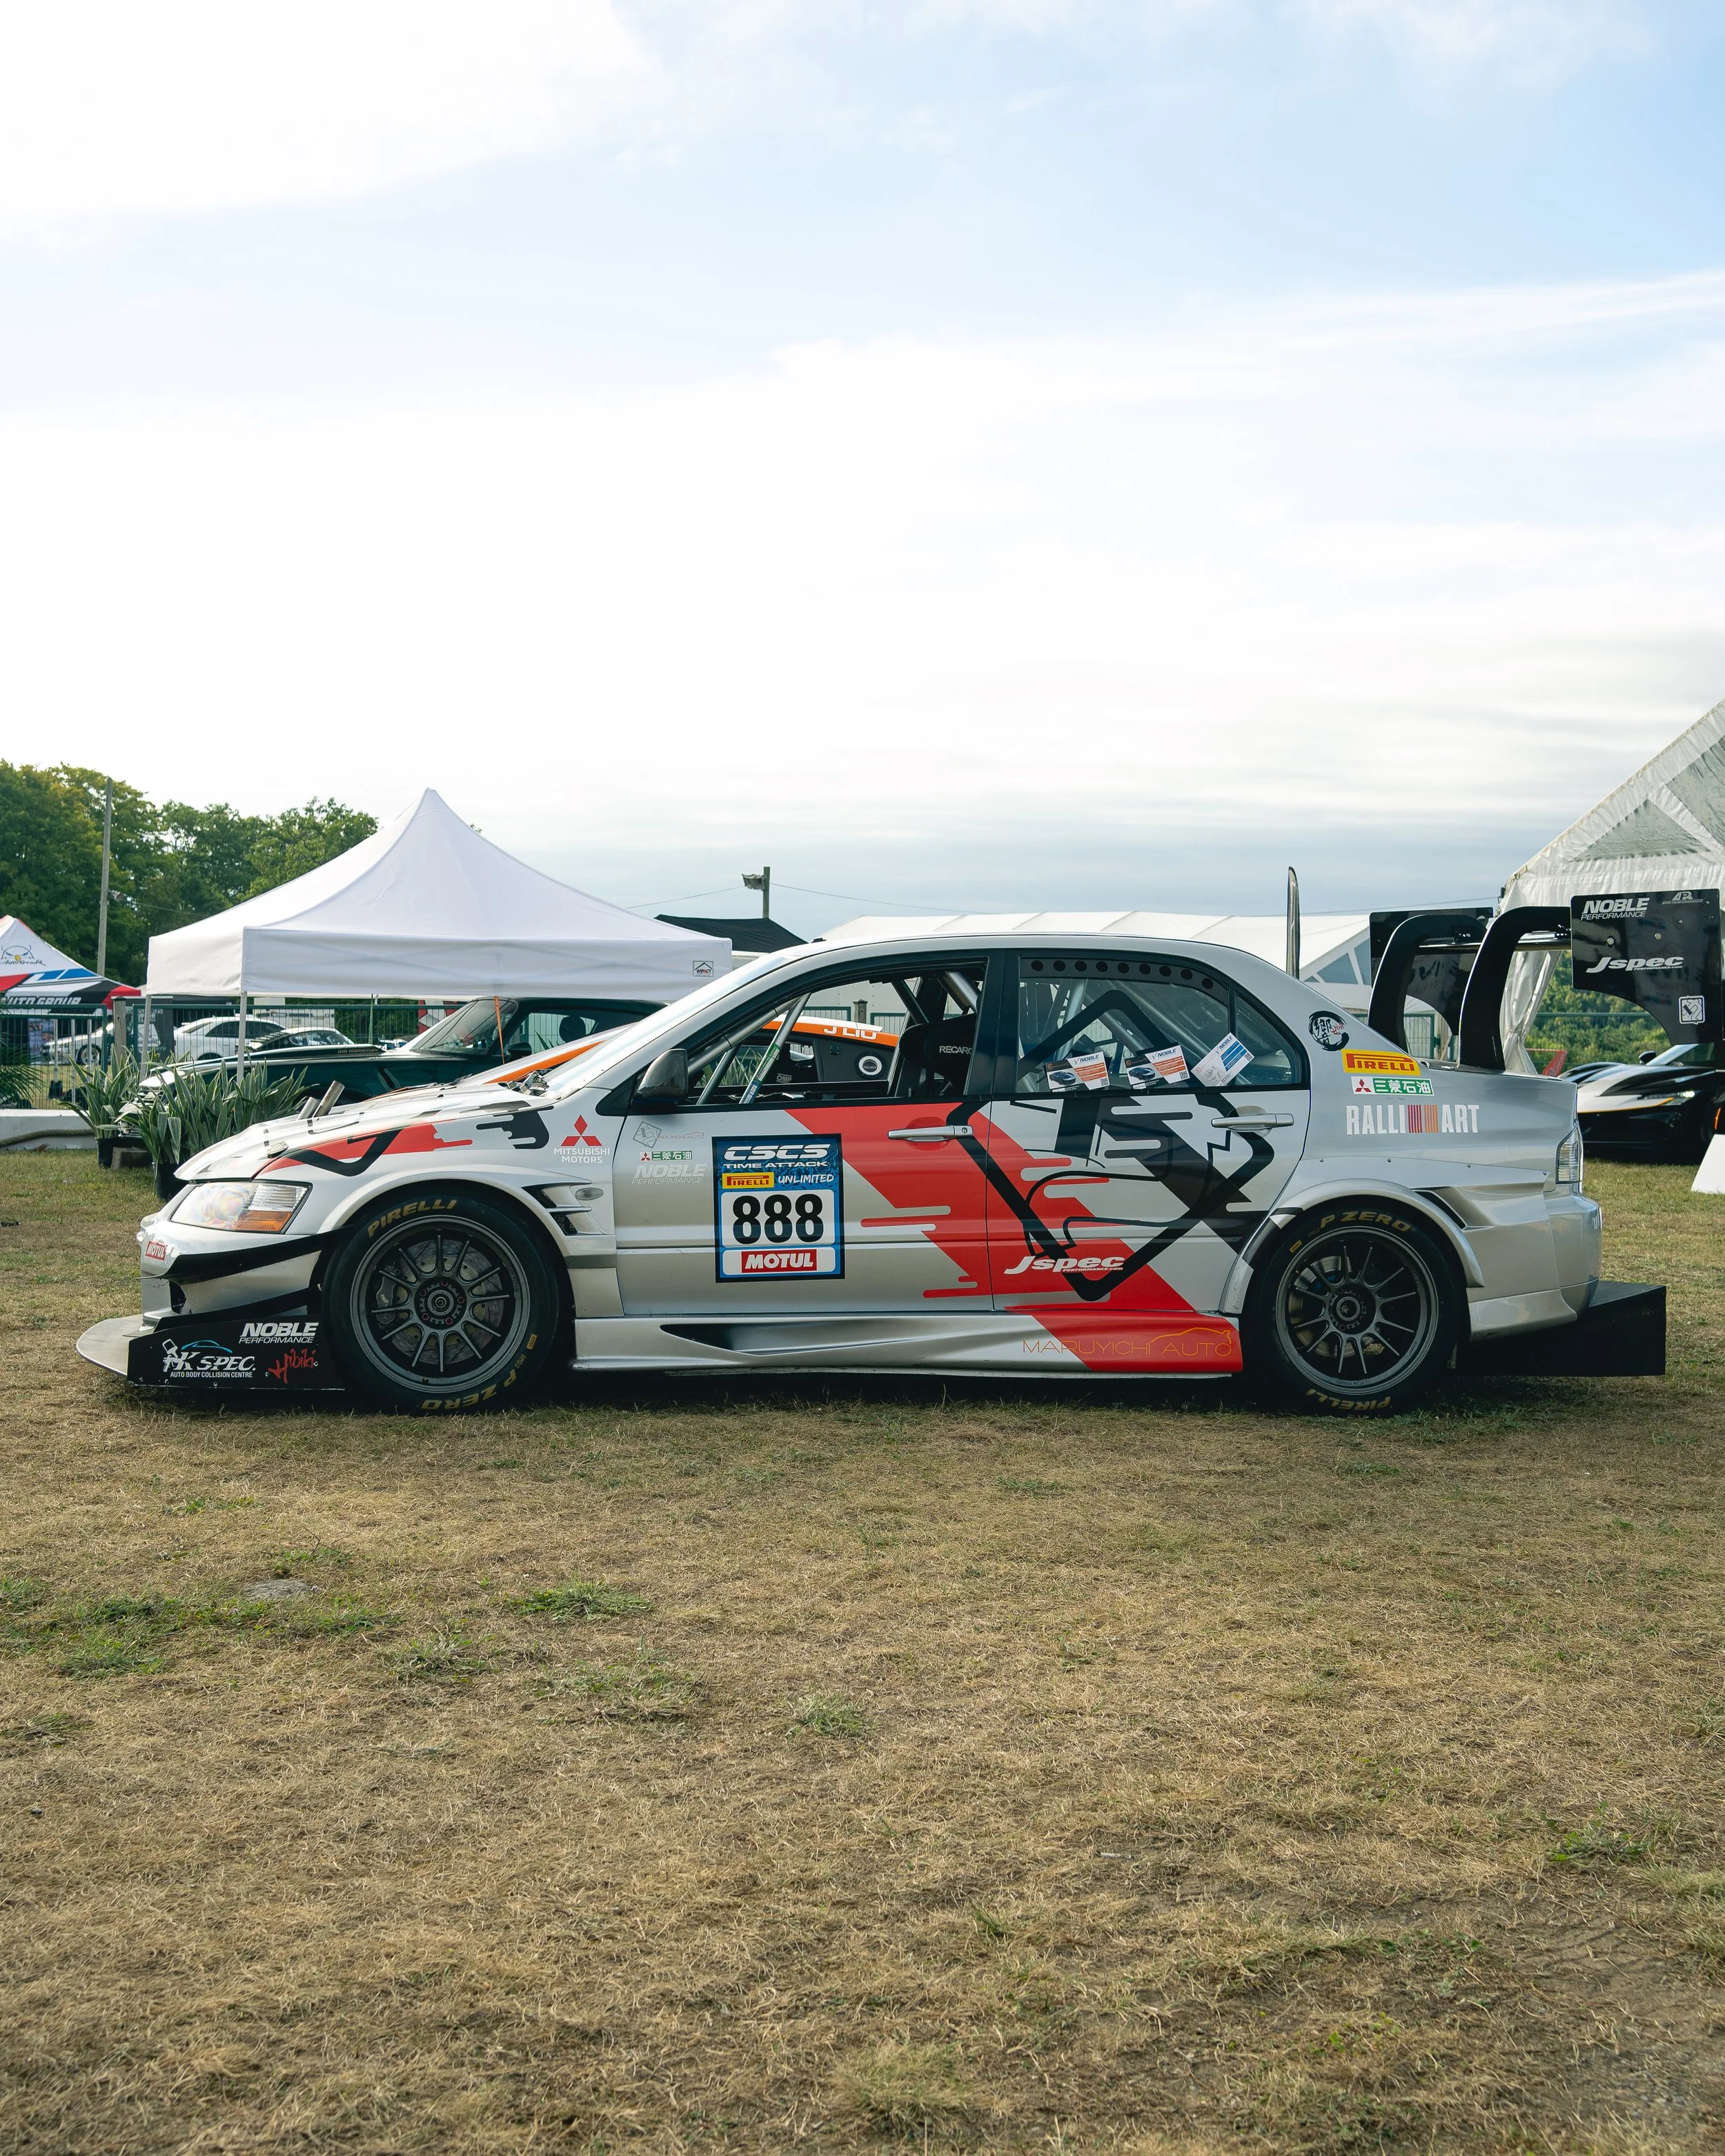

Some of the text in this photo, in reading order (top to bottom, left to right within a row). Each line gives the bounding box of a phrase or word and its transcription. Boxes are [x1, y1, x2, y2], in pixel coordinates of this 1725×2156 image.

[1581, 898, 1650, 913] NOBLE
[1581, 911, 1646, 920] PERFORMANCE
[1586, 957, 1684, 973] Jspec
[823, 1026, 878, 1040] J LIU
[1219, 1036, 1233, 1050] NOBLE
[1080, 1054, 1099, 1062] NOBLE
[1158, 1049, 1176, 1058] NOBLE
[1346, 1054, 1414, 1071] PIRELLI
[1374, 1079, 1432, 1094] 三菱石油
[724, 1144, 831, 1160] CSCS
[633, 1164, 707, 1178] NOBLE
[778, 1174, 834, 1184] UNLIMITED
[727, 1175, 769, 1186] PIRELLI
[367, 1199, 457, 1238] PIRELLI
[733, 1194, 824, 1245] 888
[1320, 1214, 1335, 1229] P
[1341, 1211, 1411, 1232] ZERO
[147, 1243, 165, 1258] MOTUL
[745, 1253, 814, 1269] MOTUL
[1004, 1256, 1125, 1275] Jspec
[239, 1323, 319, 1337] NOBLE
[1023, 1339, 1232, 1356] MARUYICHI AUTO
[268, 1348, 317, 1384] Hibiki
[504, 1369, 517, 1387] P
[422, 1384, 497, 1410] ZERO
[1305, 1389, 1391, 1411] PIRELLI
